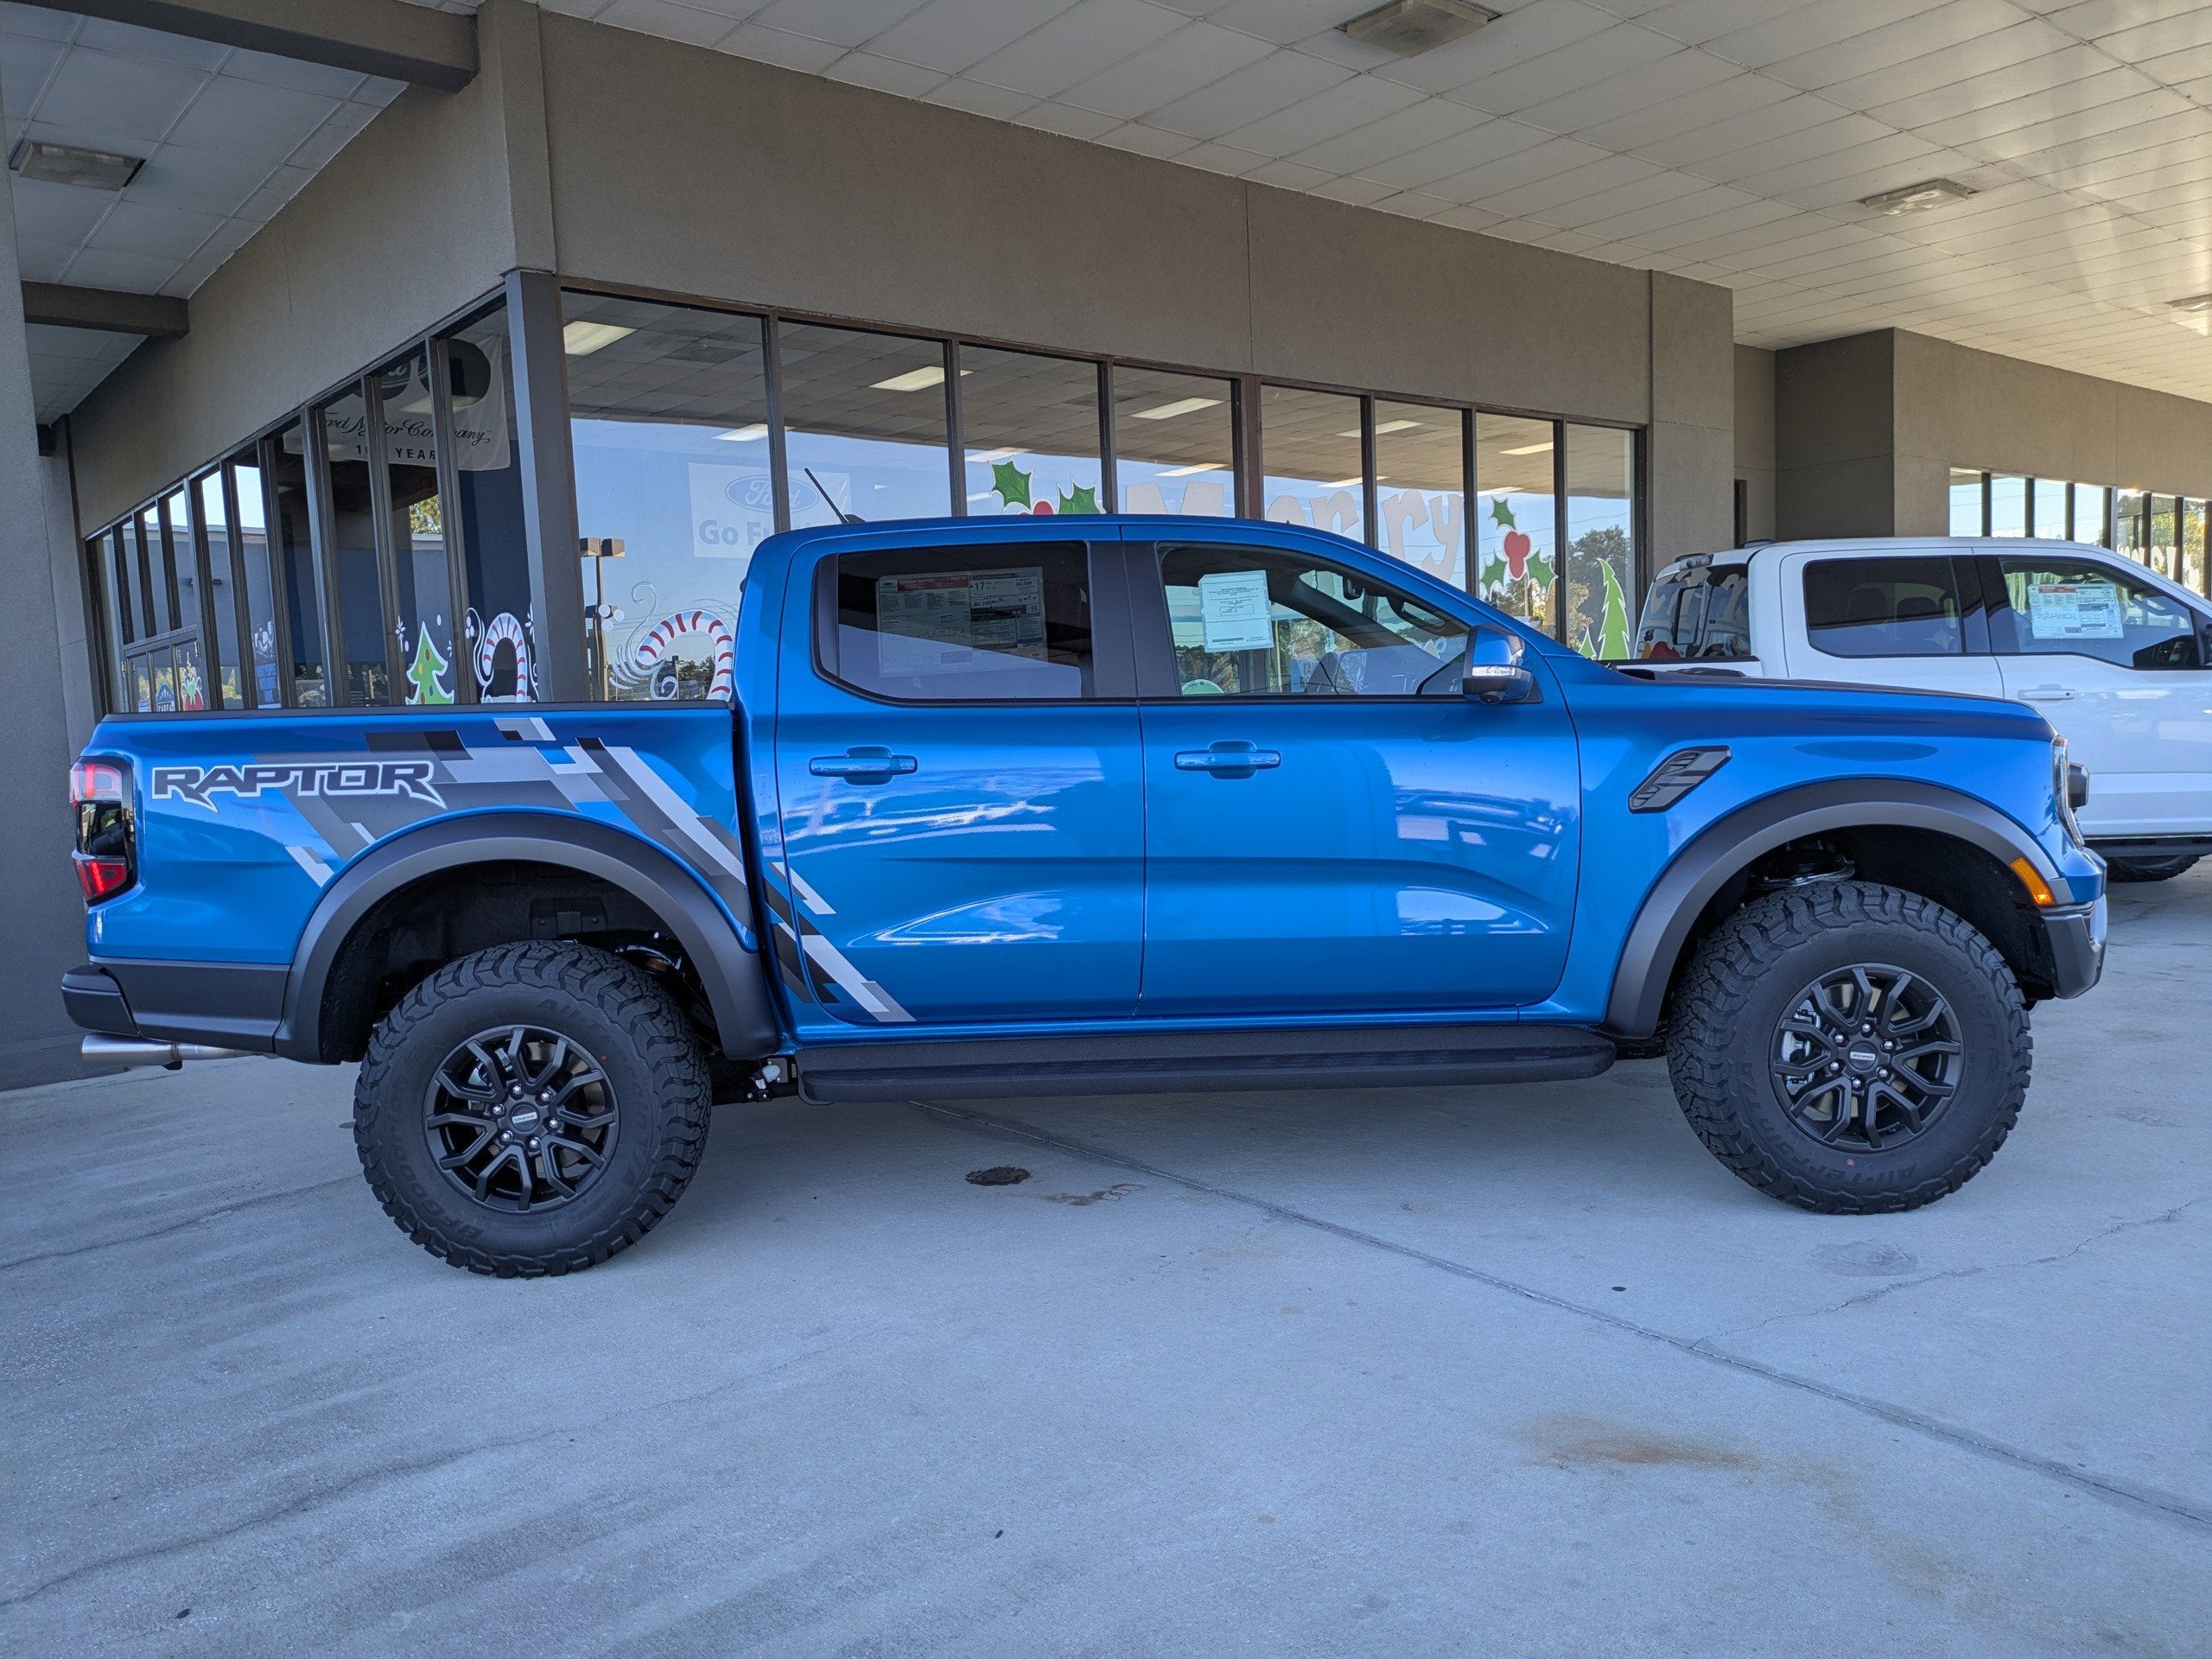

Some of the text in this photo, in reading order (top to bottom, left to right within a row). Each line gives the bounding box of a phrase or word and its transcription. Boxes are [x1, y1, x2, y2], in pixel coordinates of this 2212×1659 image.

[395, 448, 435, 460] YEAR
[745, 480, 801, 507] Fod
[698, 519, 739, 545] Go
[151, 760, 448, 813] RAPTOR
